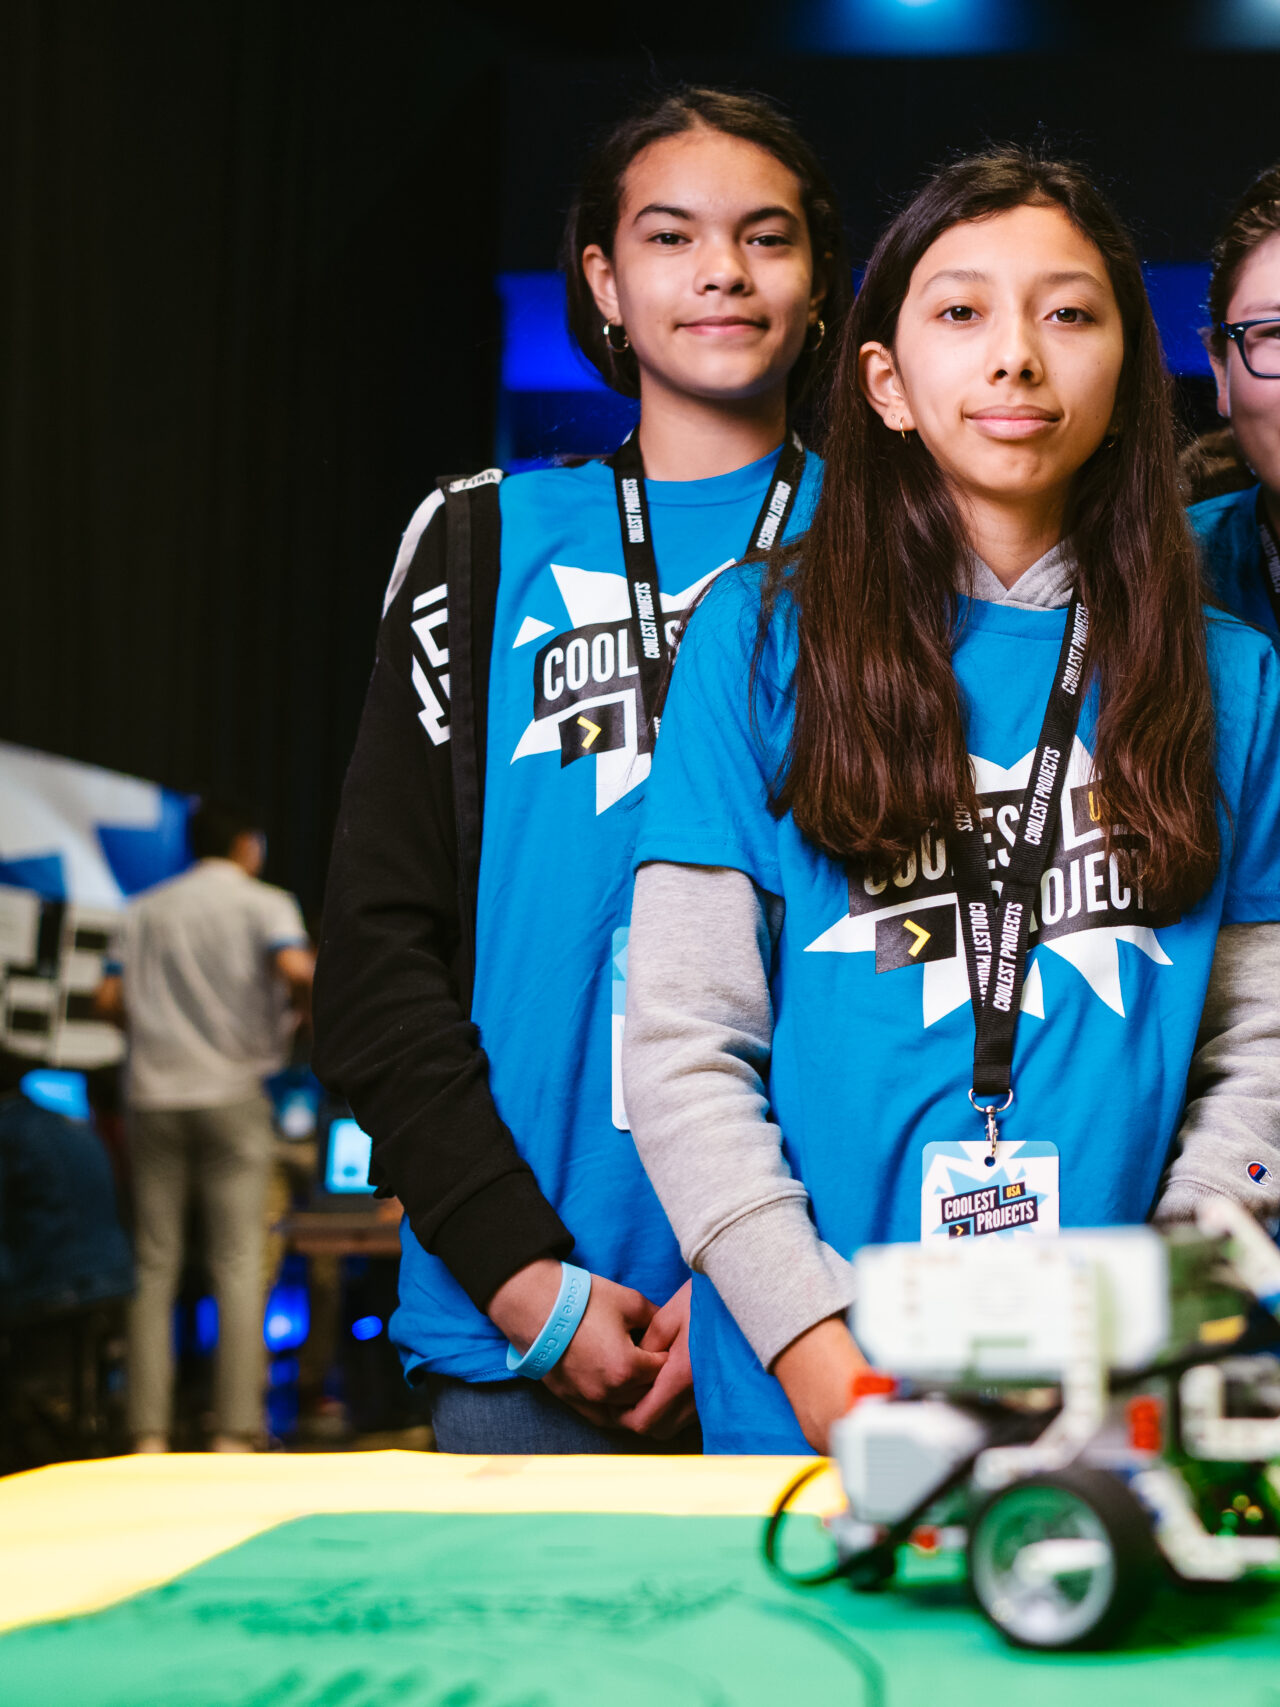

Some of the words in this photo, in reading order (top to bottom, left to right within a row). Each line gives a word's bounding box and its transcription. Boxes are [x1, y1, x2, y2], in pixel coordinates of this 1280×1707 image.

[1035, 745, 1061, 802] PROJECTS
[1024, 795, 1049, 847] COOLEST
[969, 902, 992, 953] COOLEST
[1000, 902, 1023, 960] PROJECTS
[993, 959, 1016, 1012] COOLEST
[944, 1189, 996, 1220] COOLEST
[976, 1200, 1034, 1232] PROJECTS
[1006, 1184, 1021, 1198] USA
